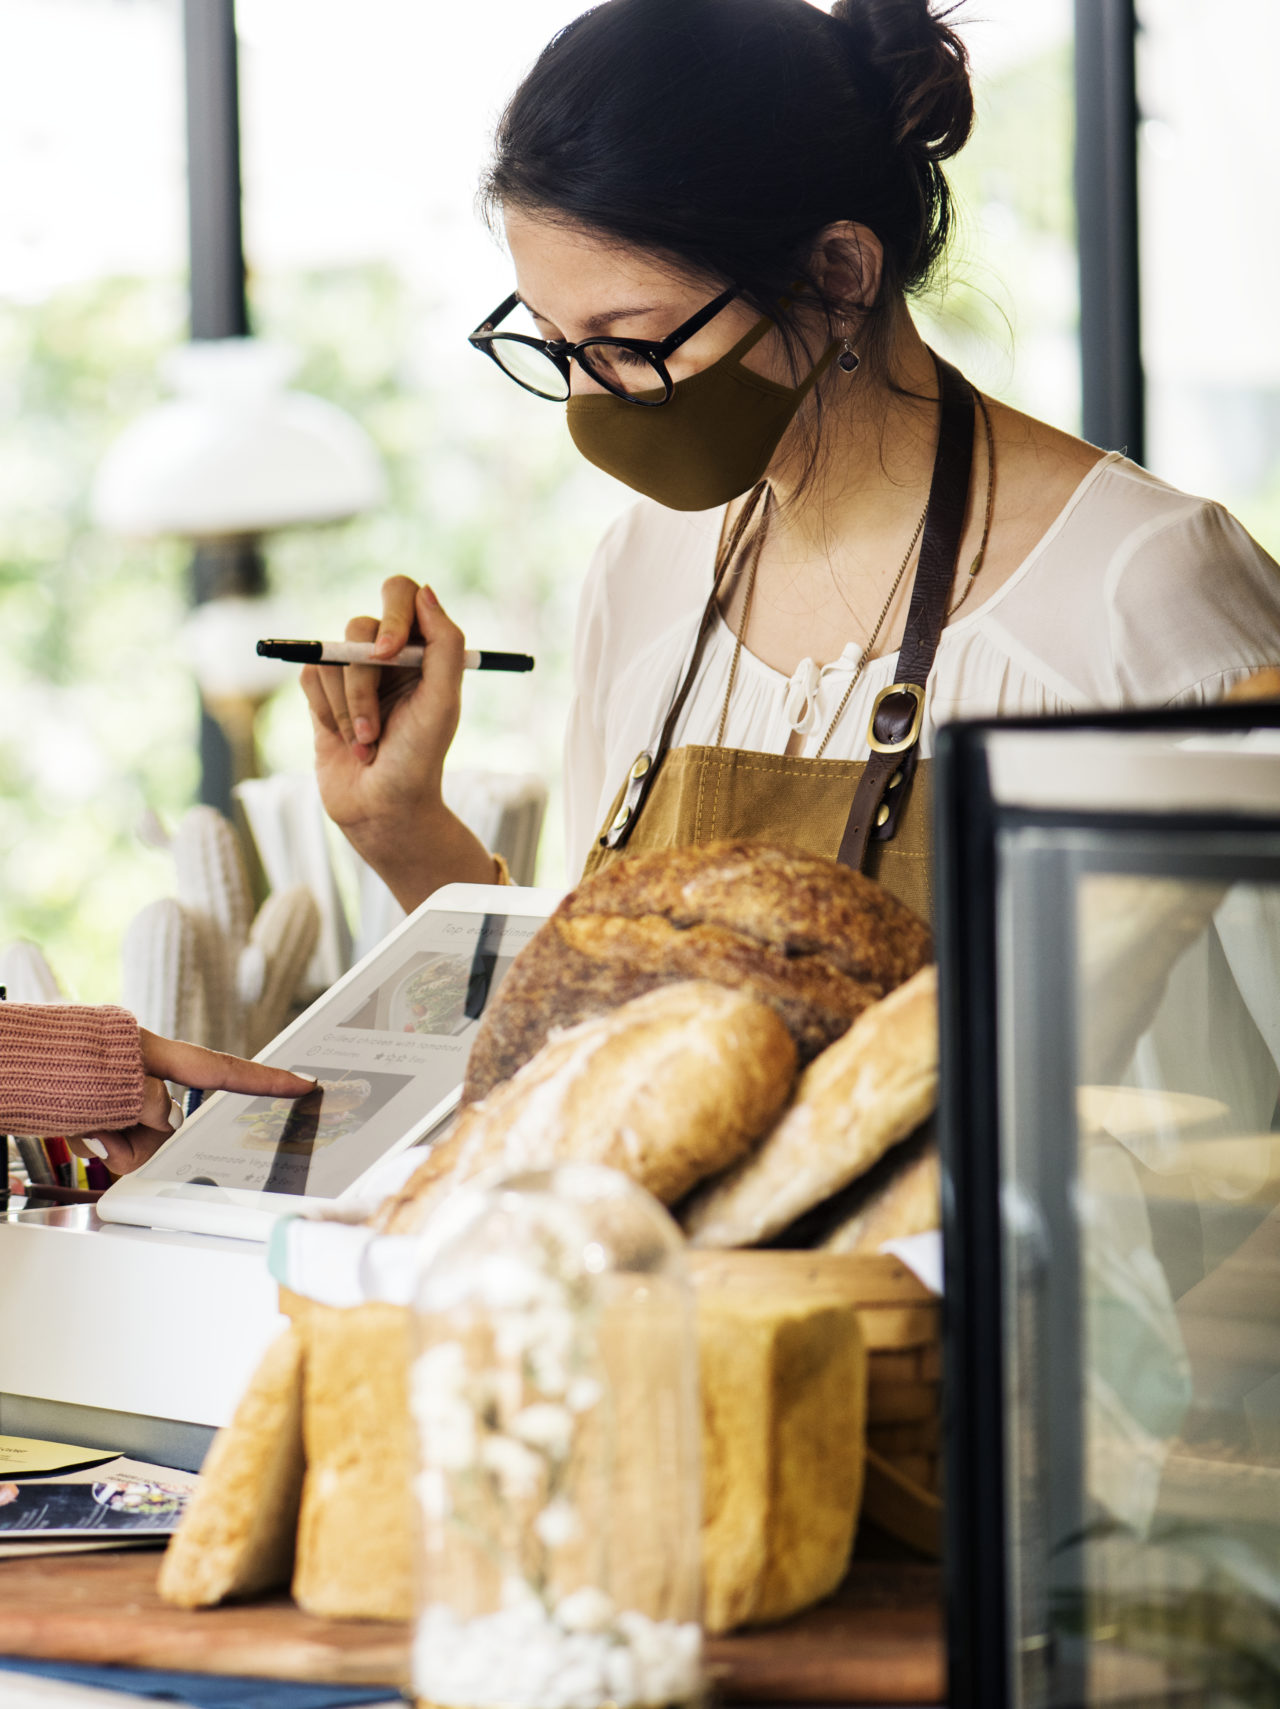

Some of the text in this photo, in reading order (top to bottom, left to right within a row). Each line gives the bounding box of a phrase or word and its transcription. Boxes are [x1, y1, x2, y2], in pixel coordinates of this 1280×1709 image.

[442, 923, 462, 935] Top
[323, 1033, 356, 1044] Grilled
[357, 1036, 393, 1048] chicken
[395, 1039, 417, 1048] with
[192, 1152, 246, 1164] Homemade
